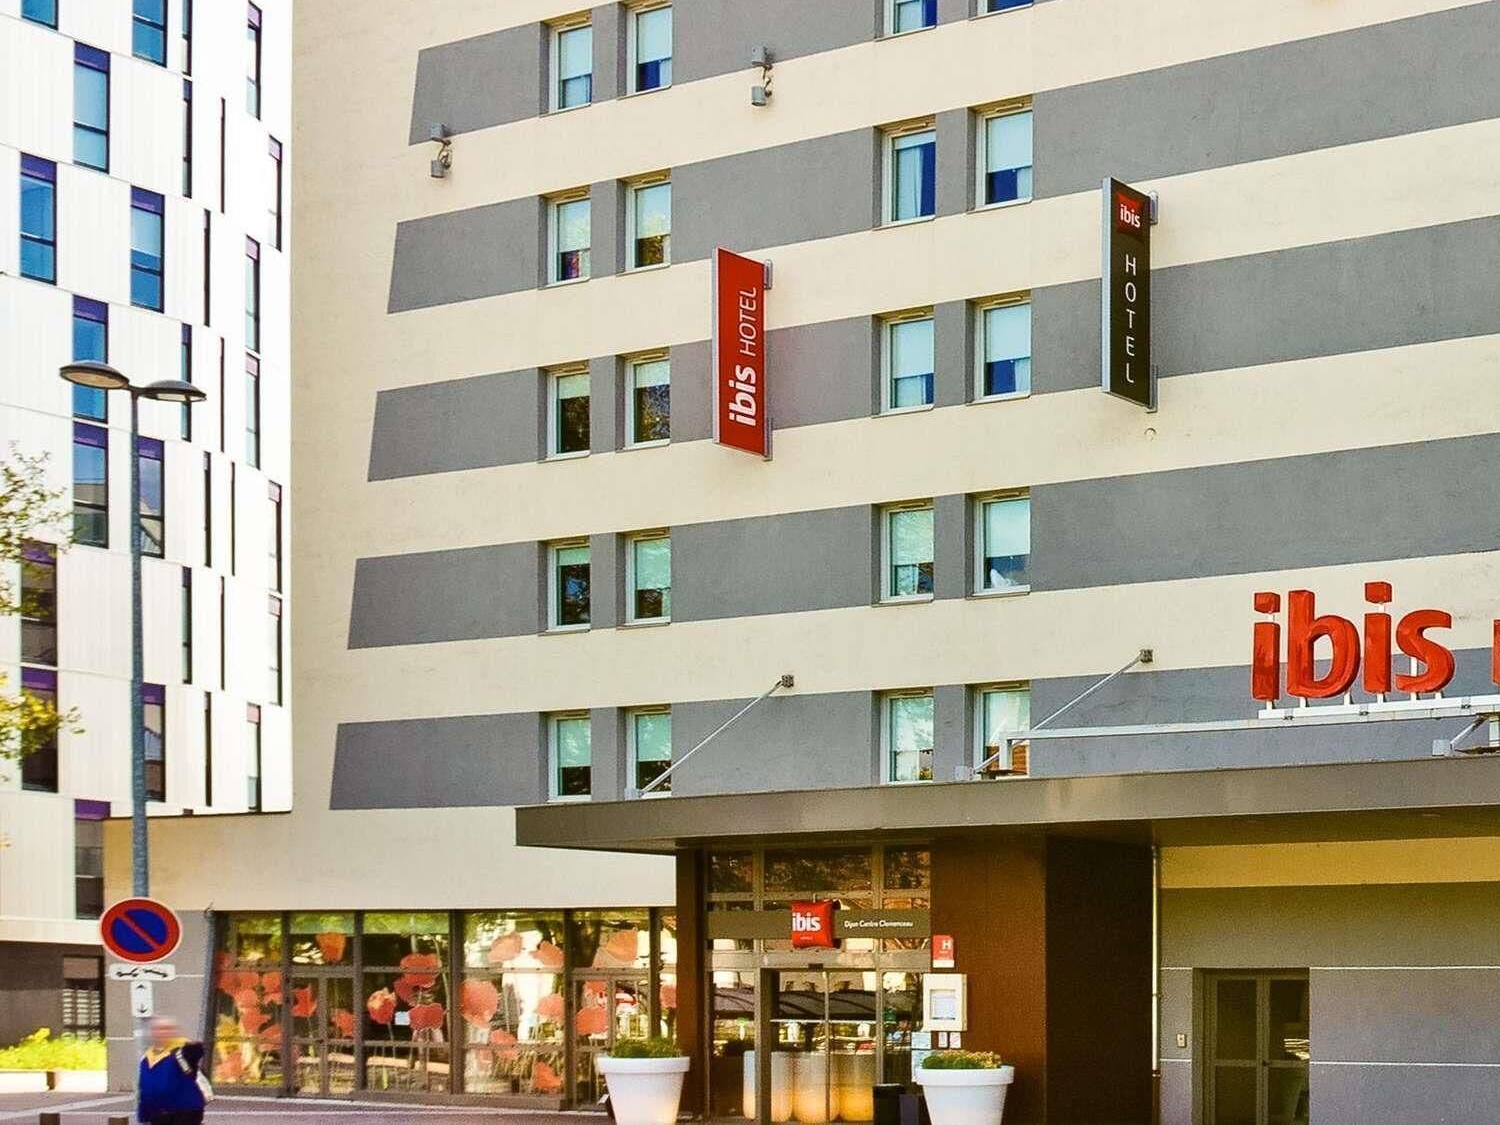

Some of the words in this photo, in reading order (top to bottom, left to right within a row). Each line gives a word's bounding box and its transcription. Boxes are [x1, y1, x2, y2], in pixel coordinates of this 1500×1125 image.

[1119, 203, 1141, 228] ibis
[739, 287, 757, 357] HOTEL
[1124, 254, 1137, 383] HOTEL
[728, 364, 757, 427] ibis
[1251, 581, 1456, 702] ibis
[792, 912, 821, 932] ibis
